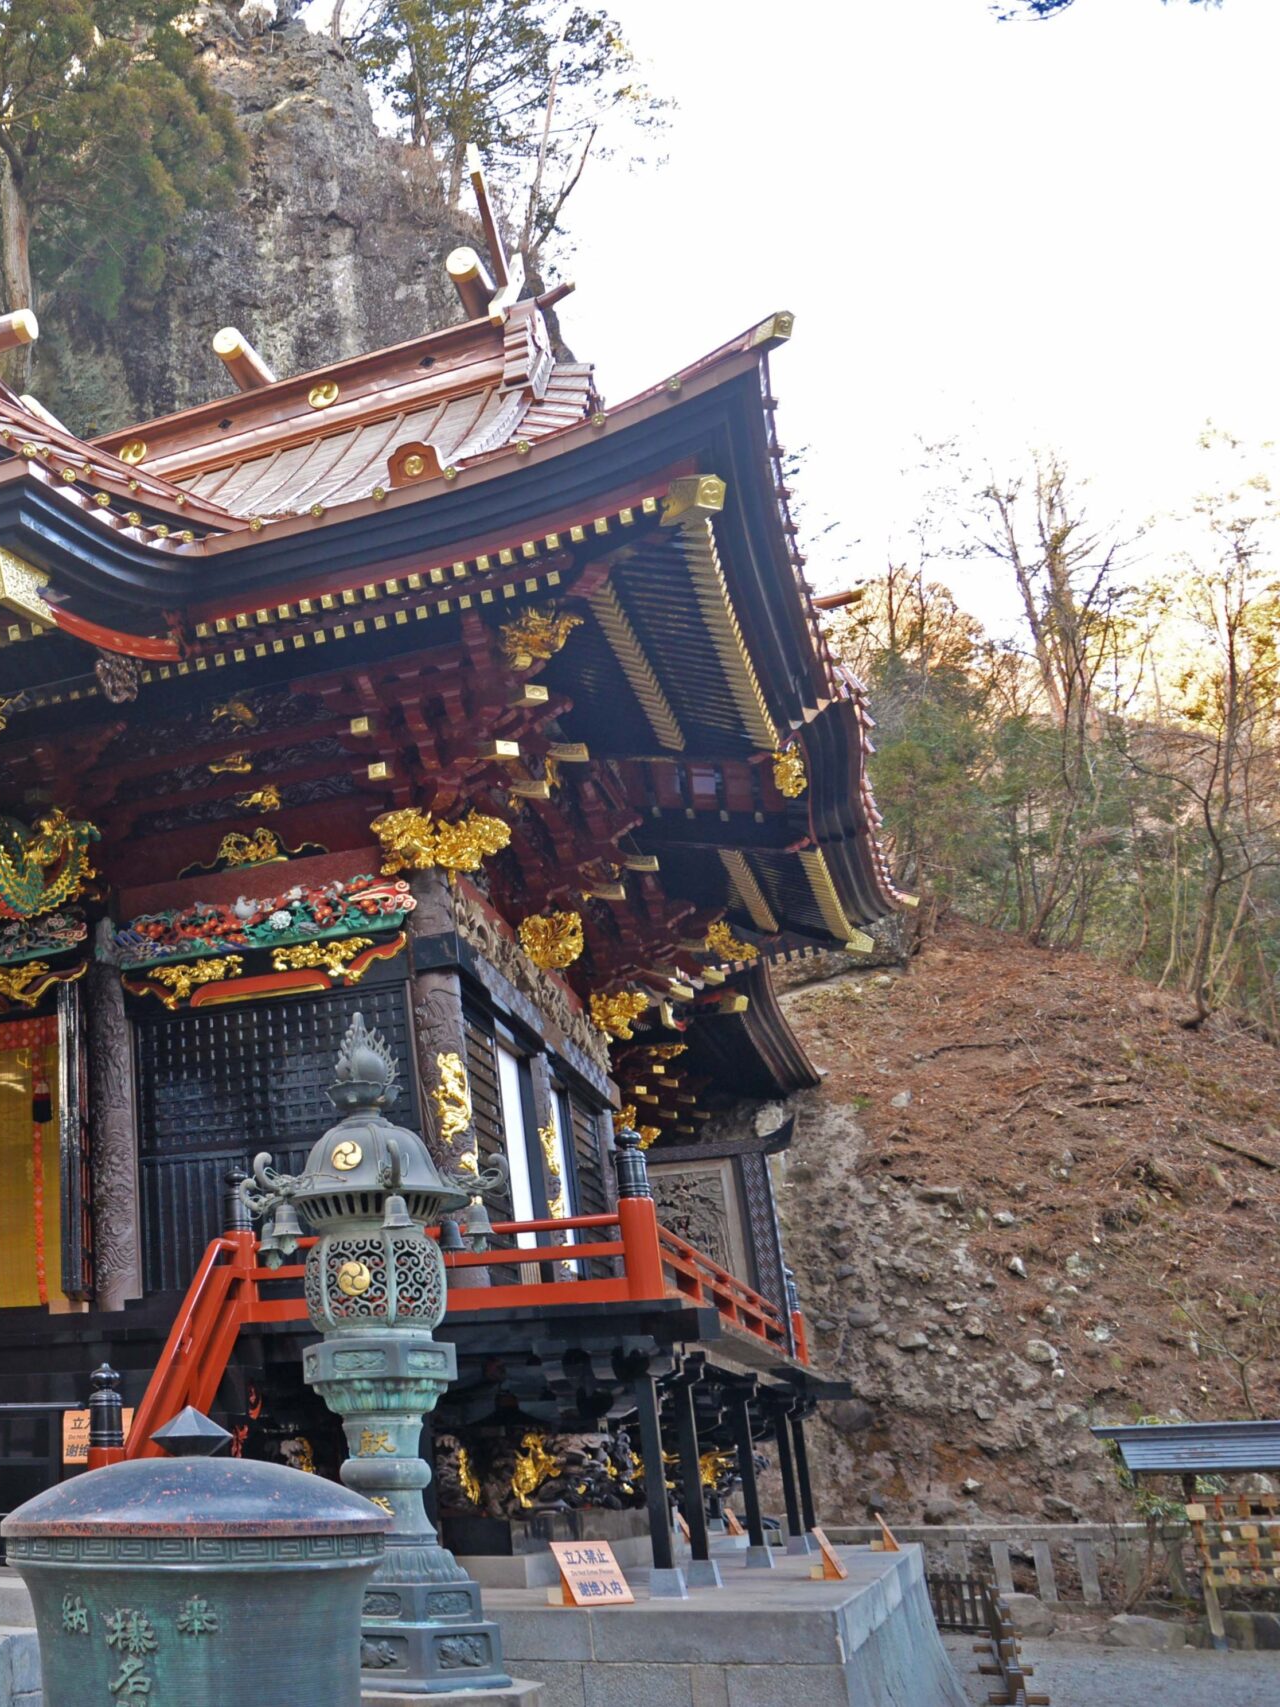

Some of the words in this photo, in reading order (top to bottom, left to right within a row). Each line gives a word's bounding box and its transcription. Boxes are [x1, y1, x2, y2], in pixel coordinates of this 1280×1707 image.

[563, 1549, 609, 1565] 立入禁止
[106, 1608, 159, 1707] 榛名
